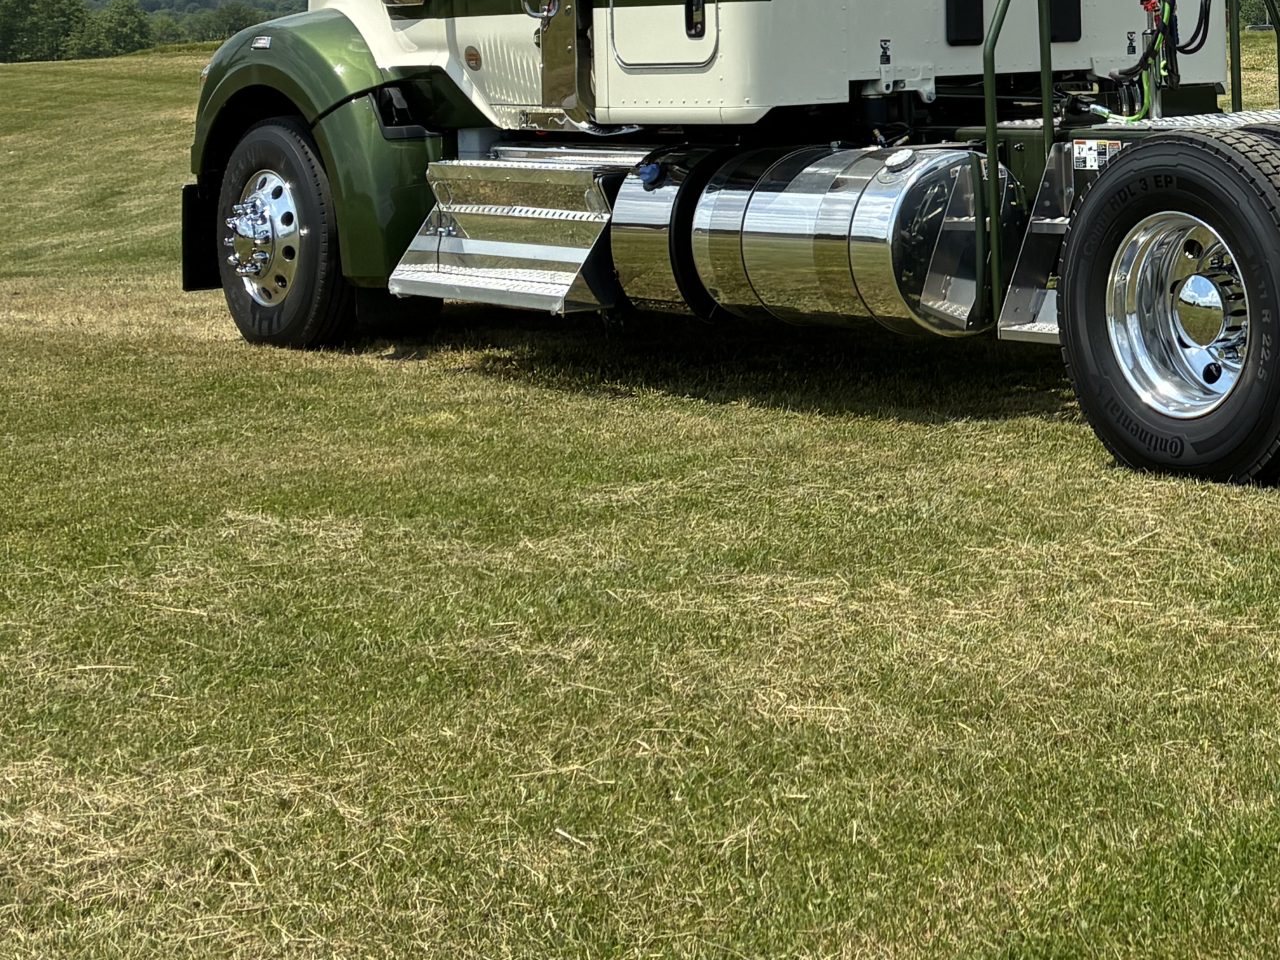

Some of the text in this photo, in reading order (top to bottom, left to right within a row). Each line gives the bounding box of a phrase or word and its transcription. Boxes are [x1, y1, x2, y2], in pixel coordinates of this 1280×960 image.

[1139, 177, 1148, 191] 3
[1153, 174, 1174, 189] EP
[1261, 308, 1272, 324] R
[1257, 332, 1272, 381] 22.5
[1106, 395, 1184, 459] Continental
